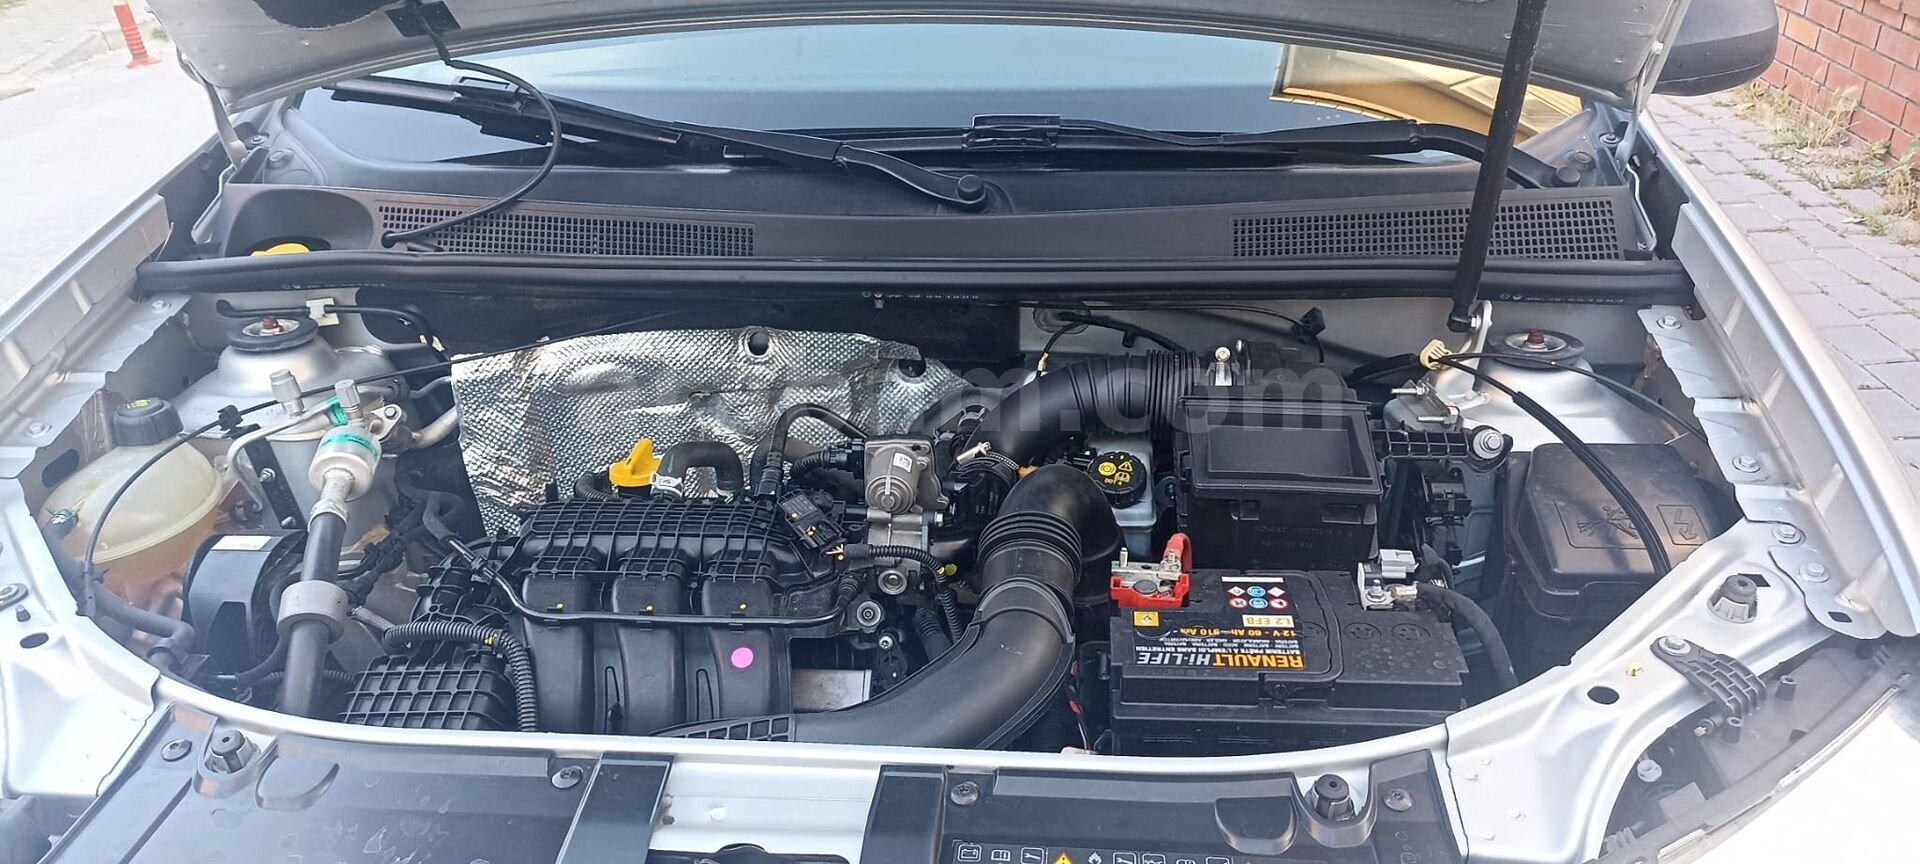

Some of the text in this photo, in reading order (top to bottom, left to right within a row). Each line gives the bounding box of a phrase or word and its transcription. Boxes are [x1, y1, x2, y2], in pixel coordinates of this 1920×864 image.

[1246, 616, 1291, 625] L2 EFB
[1282, 629, 1297, 637] 12
[1136, 652, 1304, 668] RENAULT Hi-LIFE
